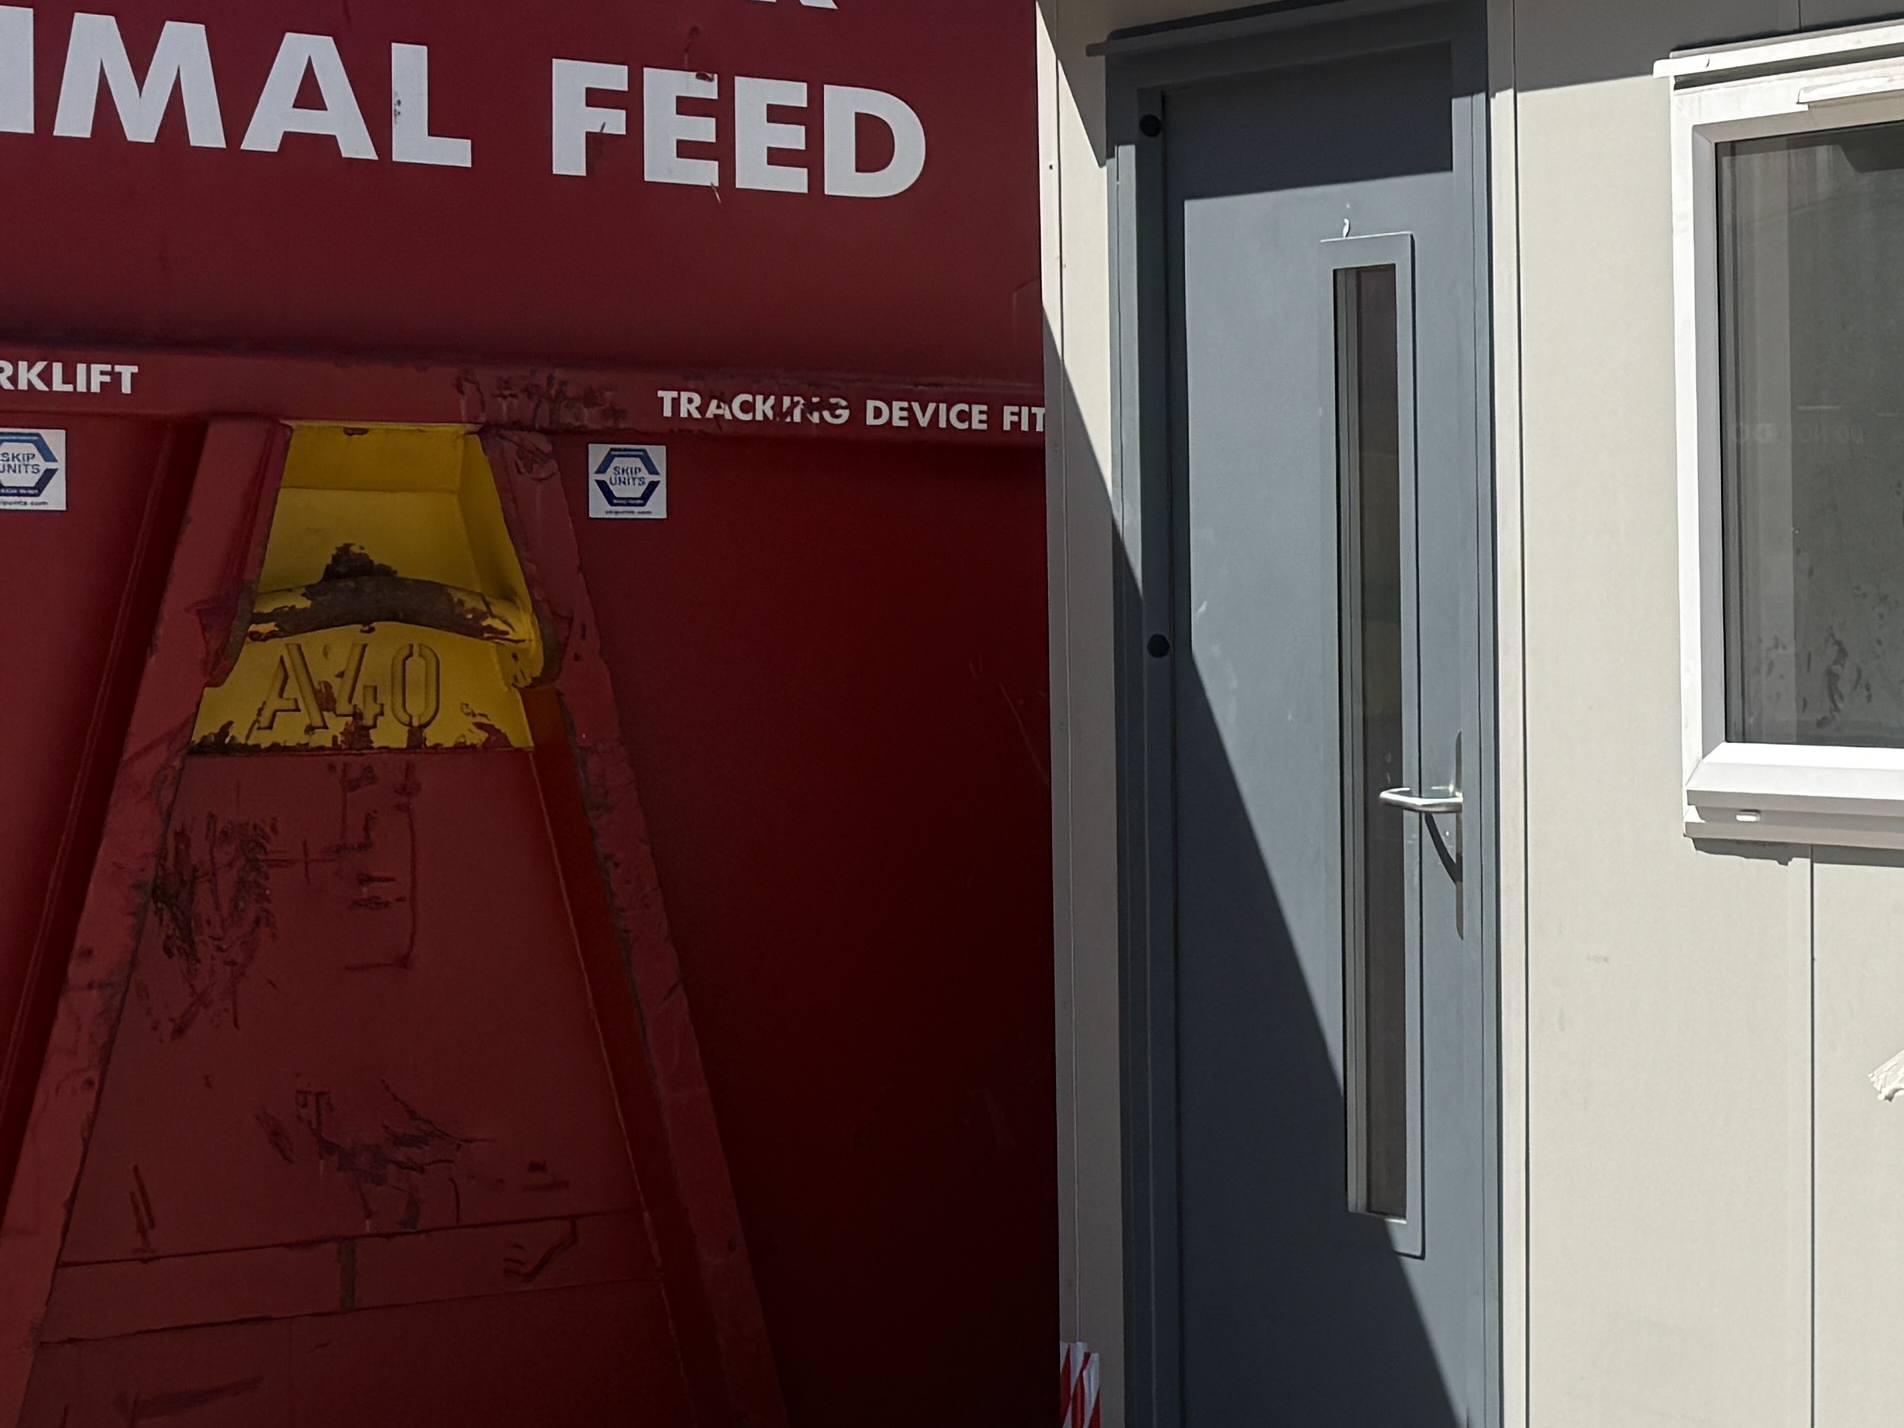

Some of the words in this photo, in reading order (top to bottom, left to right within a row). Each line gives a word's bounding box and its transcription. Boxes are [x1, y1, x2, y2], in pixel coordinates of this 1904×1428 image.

[552, 58, 926, 199] FEED
[866, 399, 988, 430] DEVICE
[0, 452, 36, 463] SKIP
[609, 476, 646, 487] UNITS
[613, 466, 642, 476] SKIP
[256, 642, 441, 731] A40
